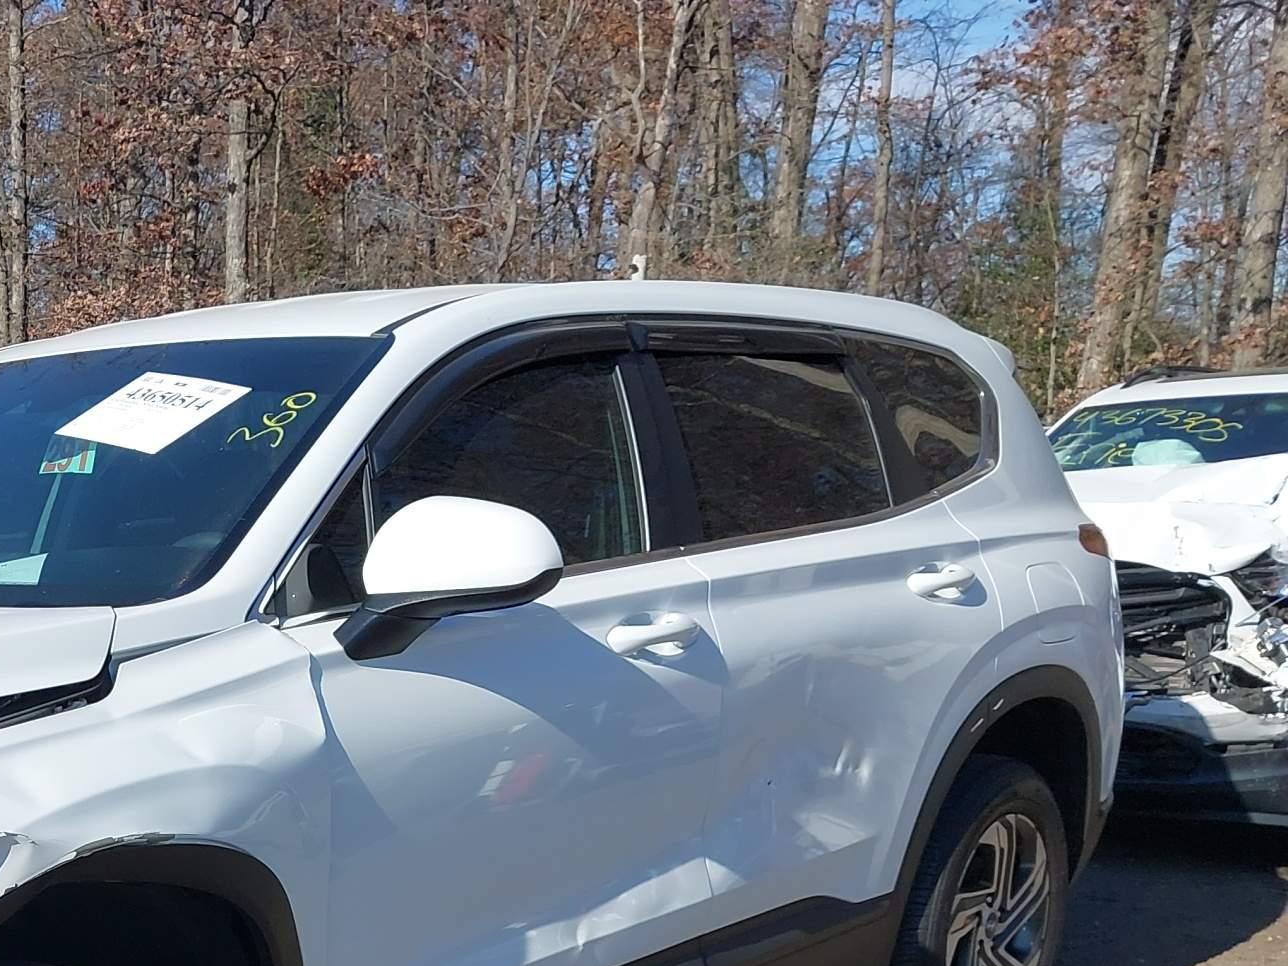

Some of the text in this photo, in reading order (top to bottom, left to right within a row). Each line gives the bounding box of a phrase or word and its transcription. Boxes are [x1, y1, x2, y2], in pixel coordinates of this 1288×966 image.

[125, 386, 214, 411] 43650514
[226, 390, 318, 450] 360
[1072, 407, 1244, 443] 43673305
